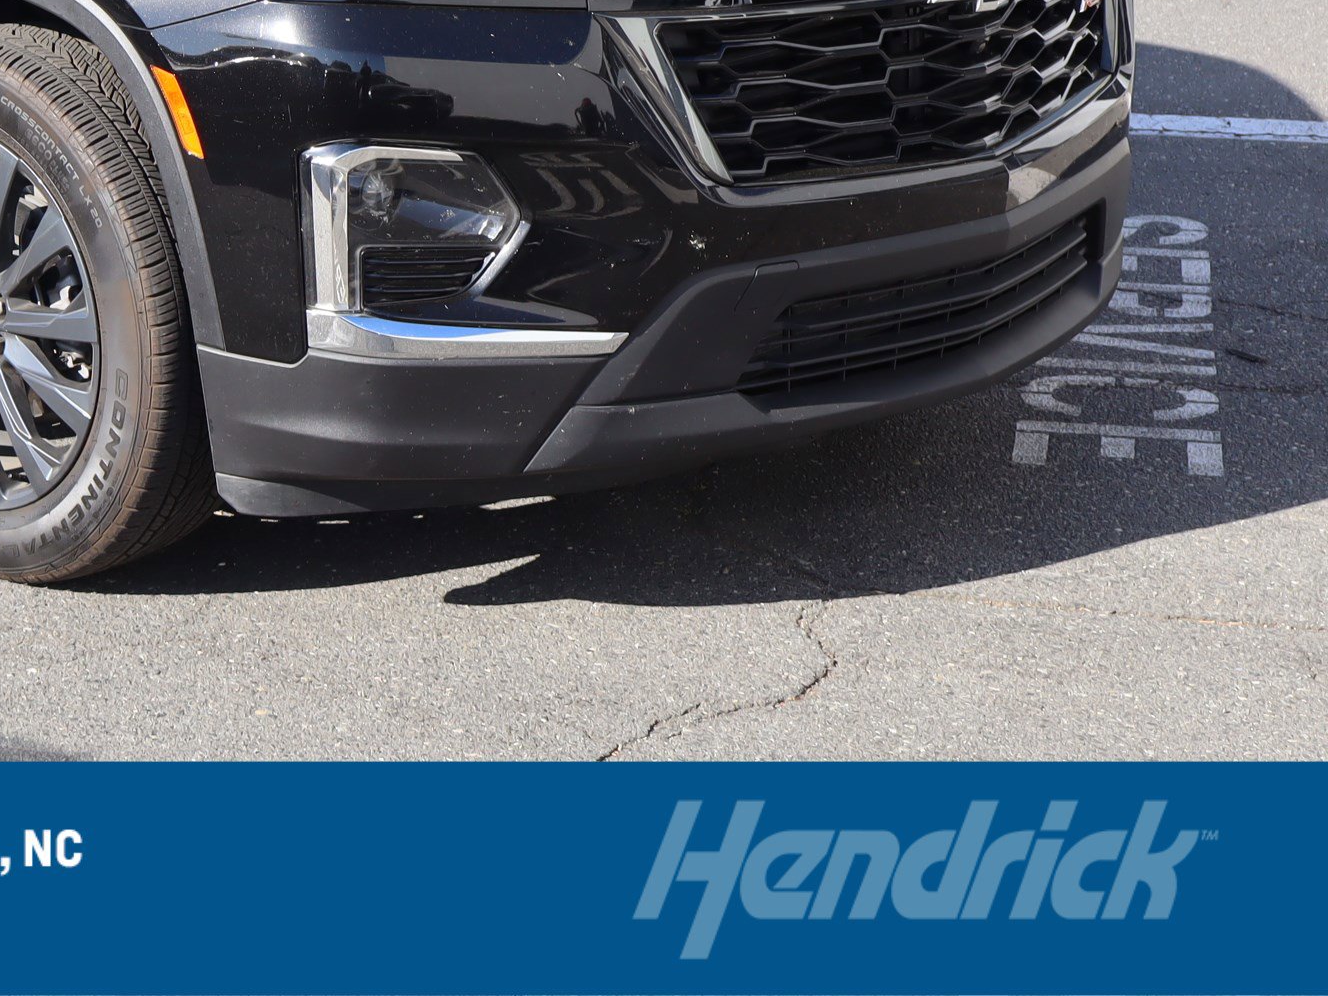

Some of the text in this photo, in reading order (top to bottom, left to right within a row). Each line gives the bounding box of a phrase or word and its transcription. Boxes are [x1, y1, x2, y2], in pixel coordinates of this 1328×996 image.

[0, 95, 80, 181] CROSSCONTACT
[79, 185, 93, 206] LX
[90, 207, 103, 229] 20
[2, 368, 129, 557] CONTINENTAL
